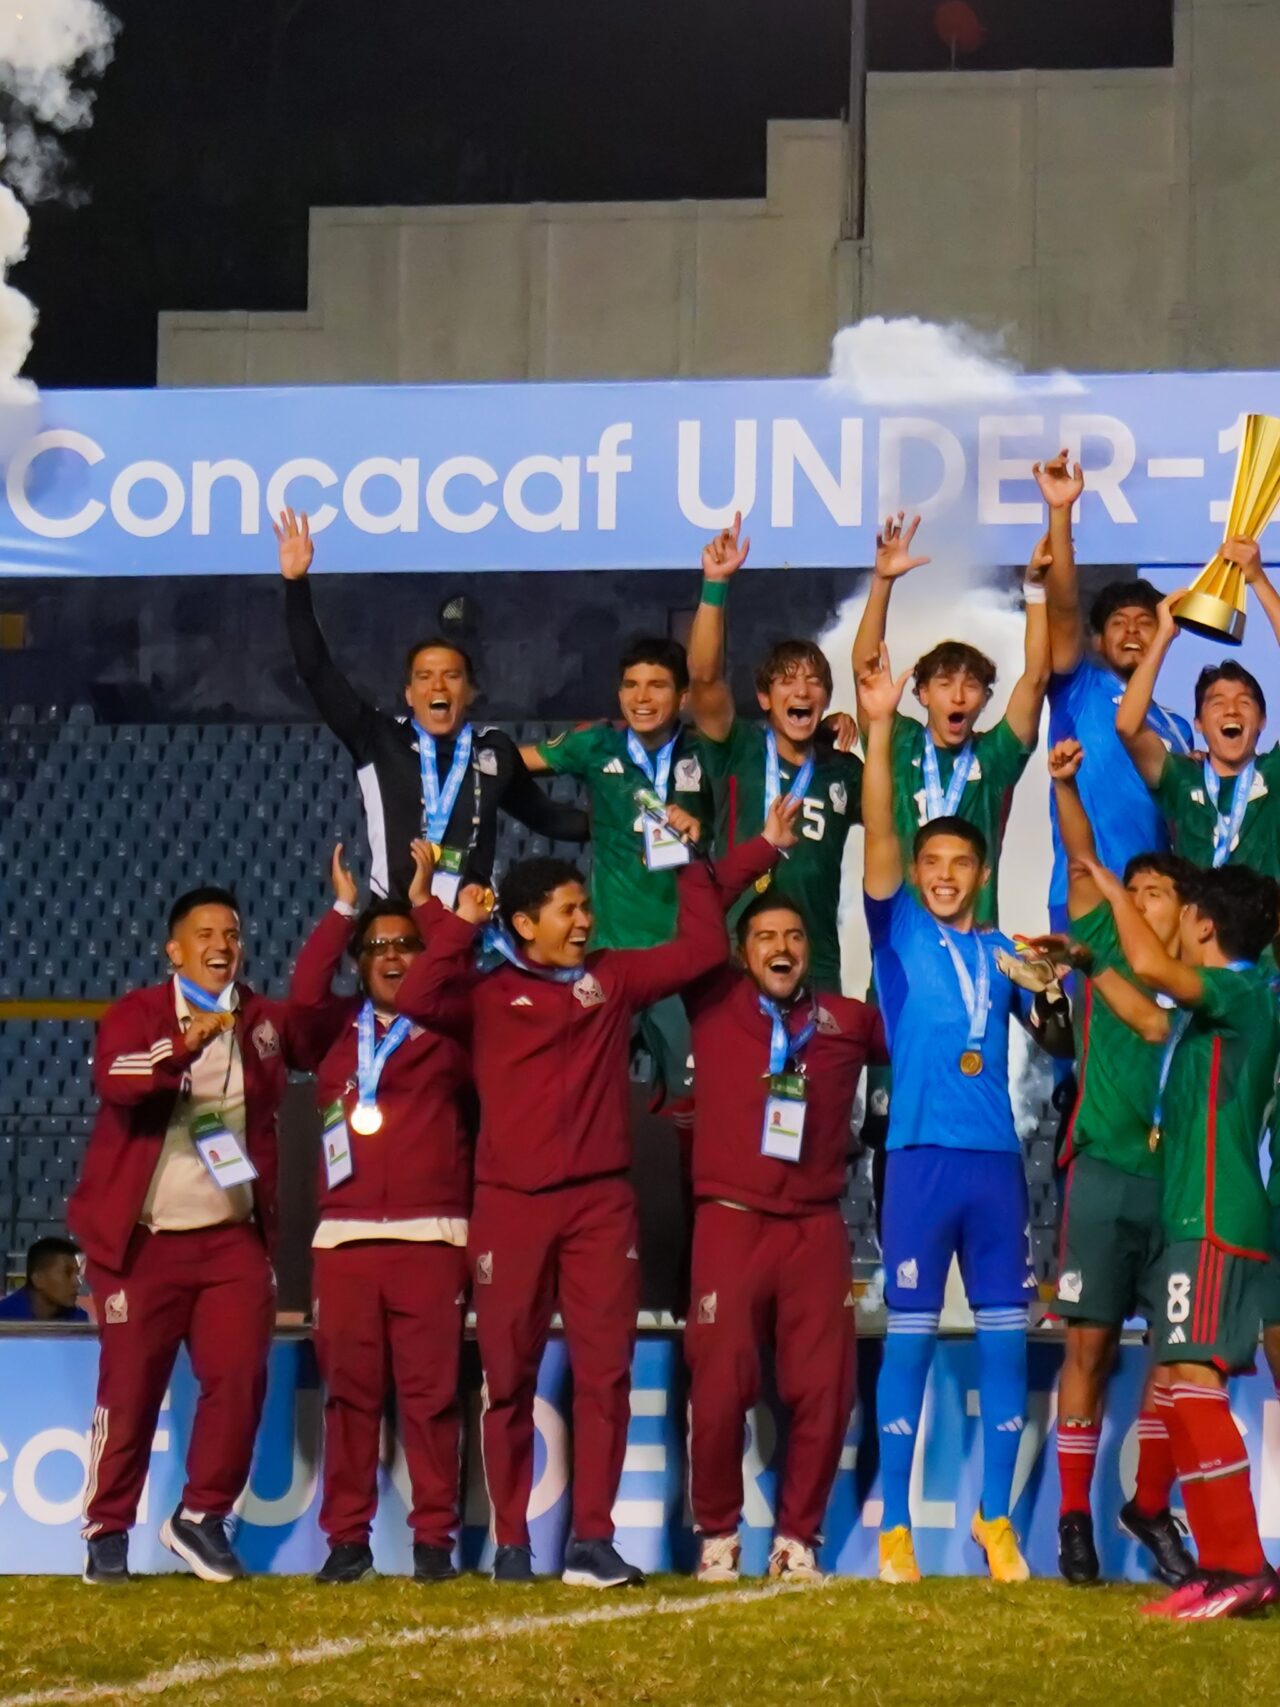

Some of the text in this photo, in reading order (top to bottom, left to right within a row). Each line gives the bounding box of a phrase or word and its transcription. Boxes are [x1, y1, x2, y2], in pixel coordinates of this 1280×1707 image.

[5, 420, 633, 539] Concacaf
[802, 797, 826, 841] 5
[1167, 1272, 1191, 1324] 8
